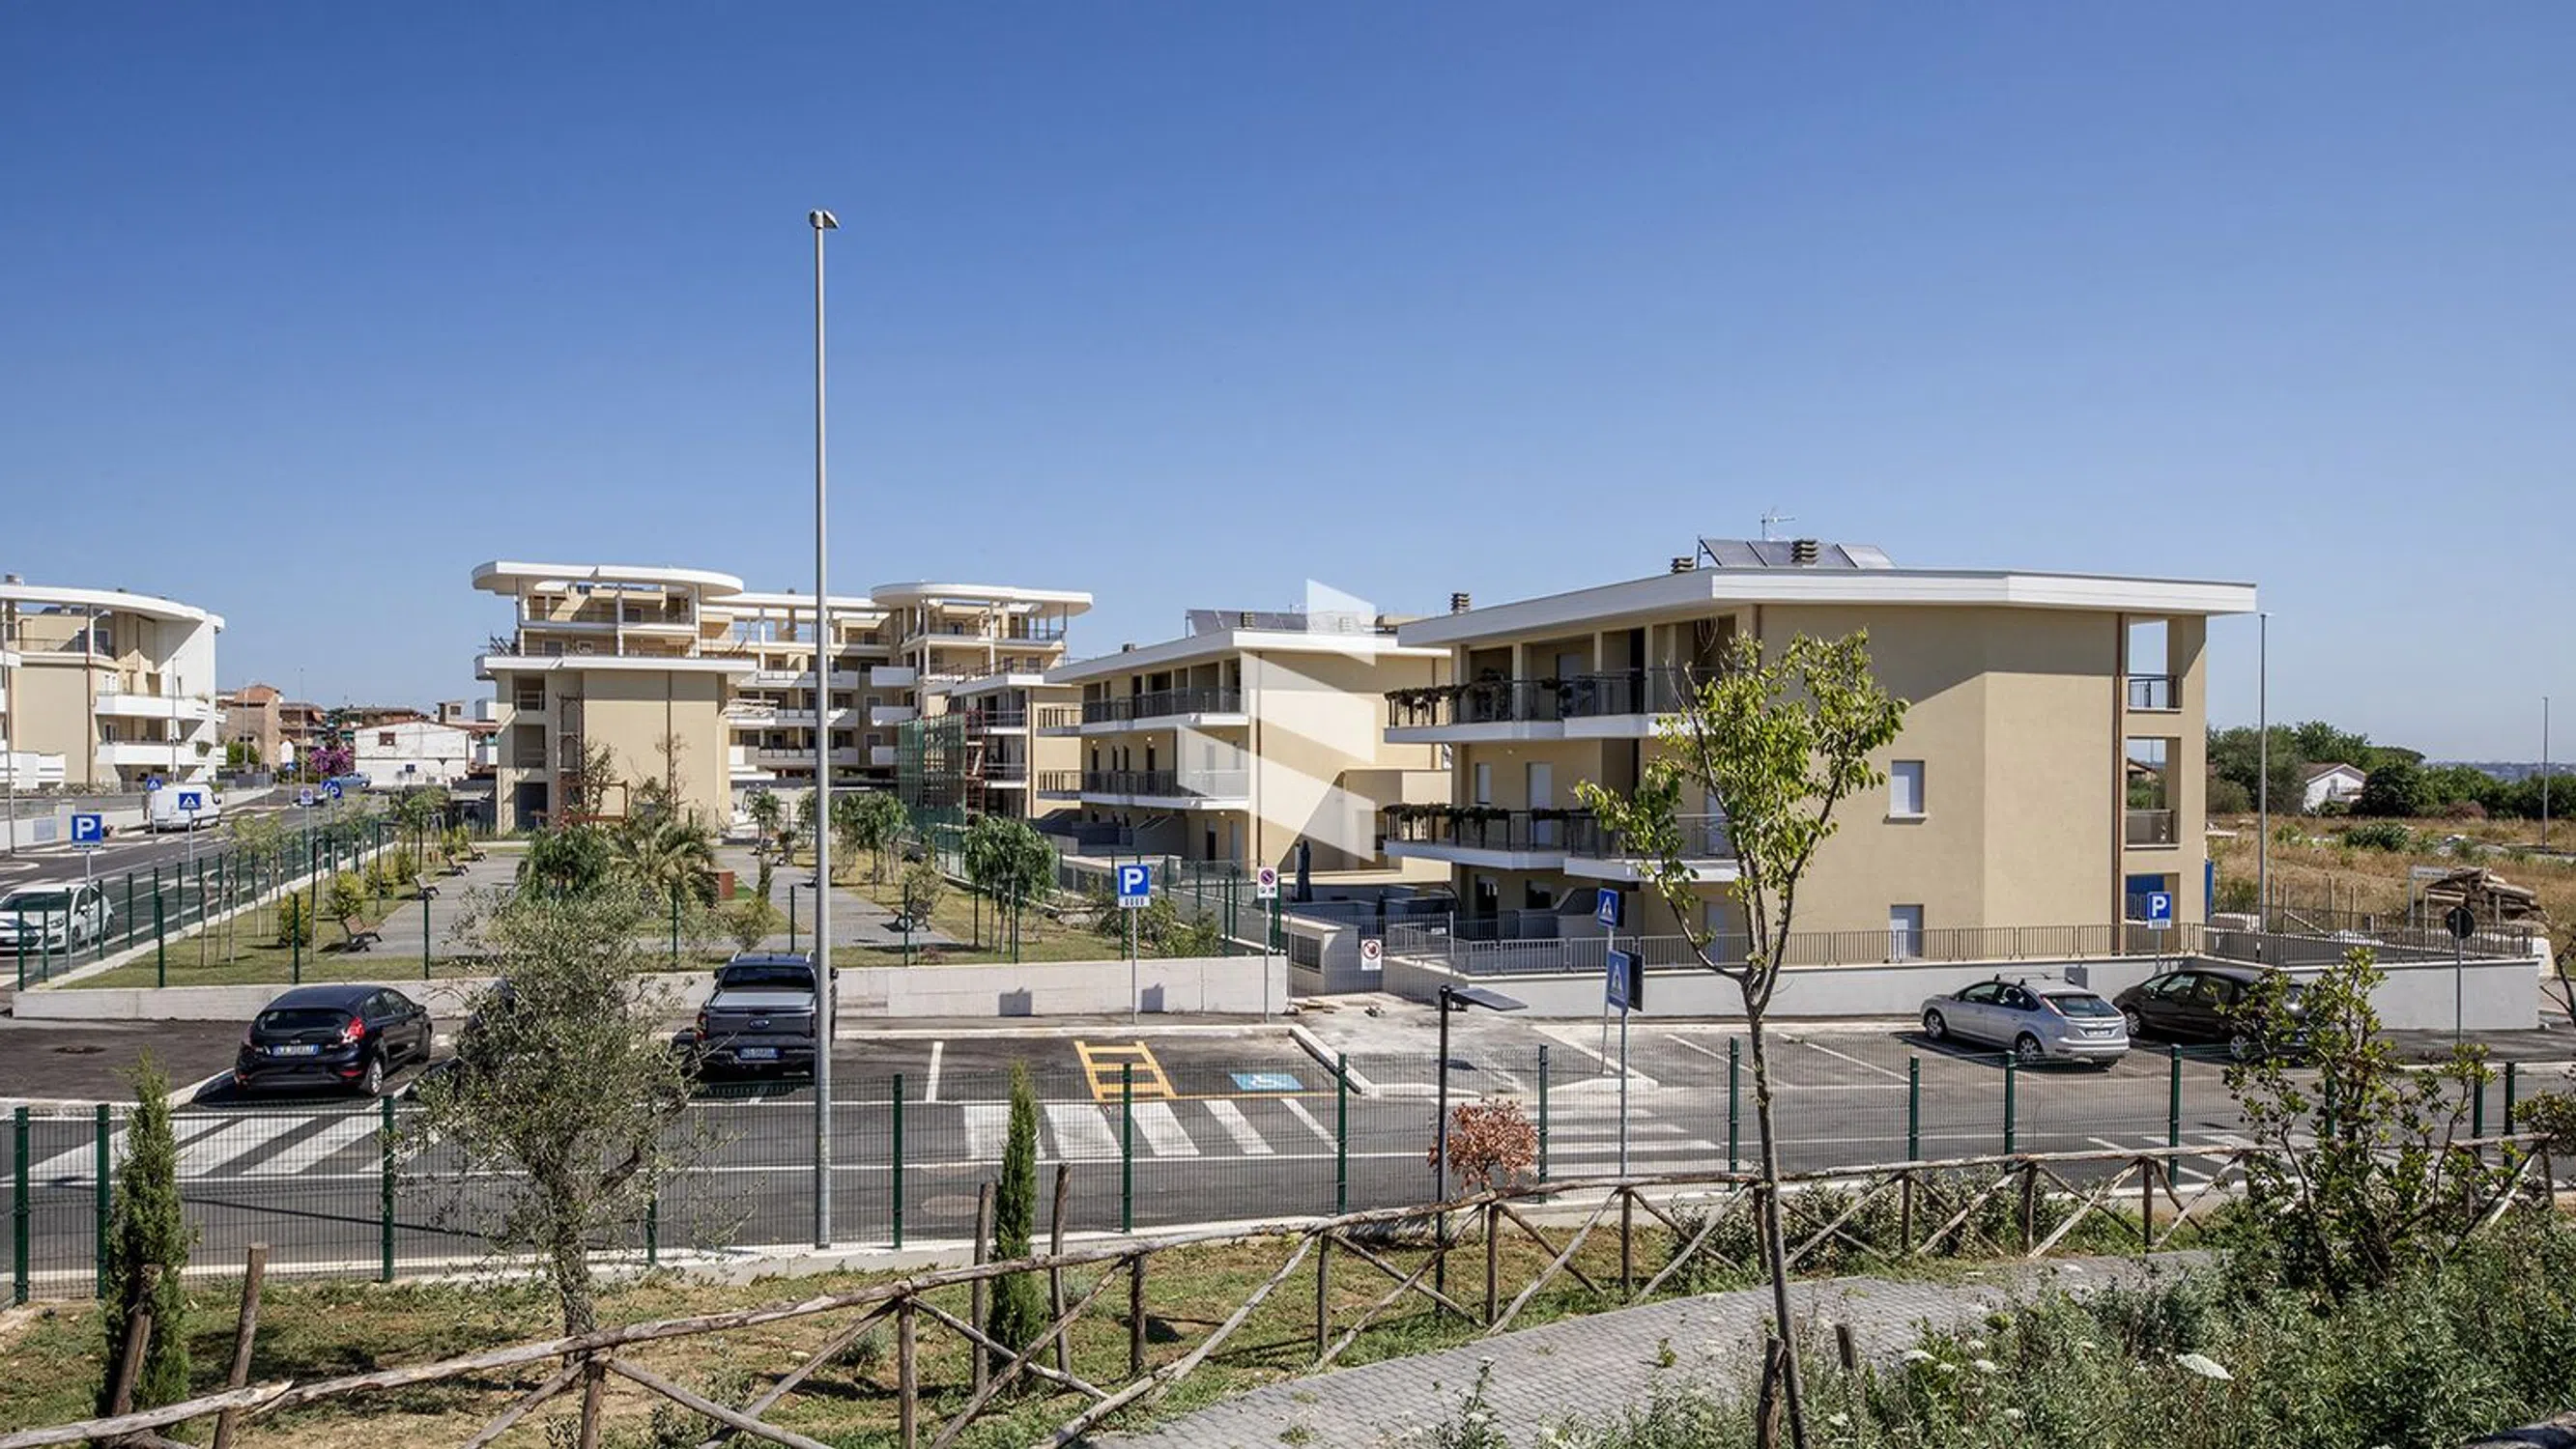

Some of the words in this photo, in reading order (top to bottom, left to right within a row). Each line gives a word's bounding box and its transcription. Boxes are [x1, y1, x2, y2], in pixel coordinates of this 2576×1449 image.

[77, 816, 96, 839] P
[1124, 868, 1144, 894] P
[2152, 895, 2167, 918] P
